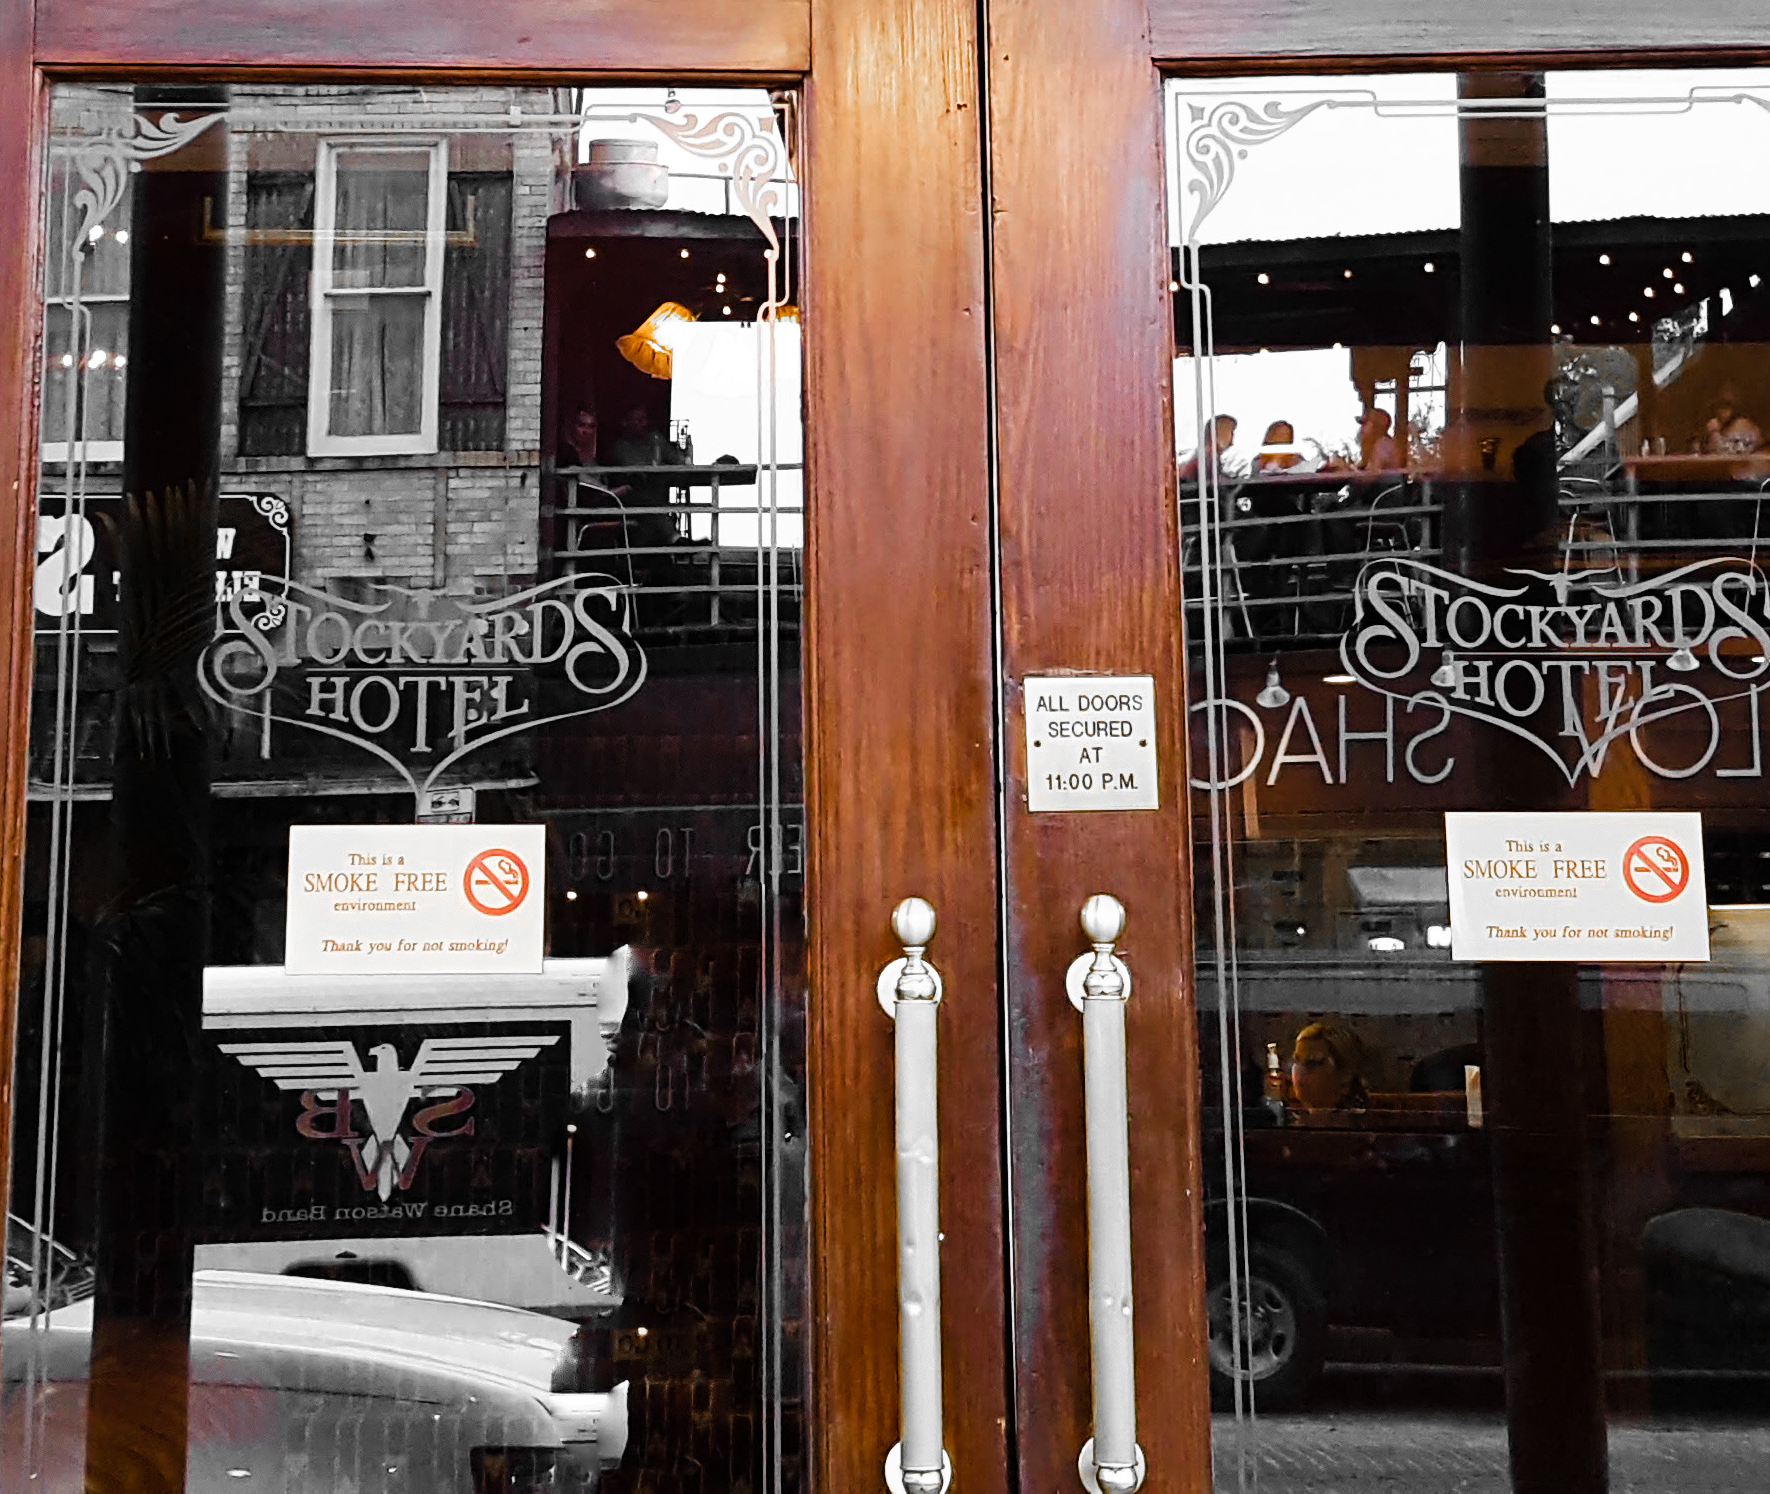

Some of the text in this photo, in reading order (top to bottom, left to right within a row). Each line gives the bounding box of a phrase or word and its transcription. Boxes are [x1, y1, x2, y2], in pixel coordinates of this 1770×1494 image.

[213, 586, 629, 696] STOCKYARDS
[1036, 694, 1143, 712] ALL DOORS
[1450, 659, 1677, 737] HOTEL
[305, 674, 529, 752] HOTEL
[1048, 720, 1133, 738] SECURED
[1078, 747, 1103, 764] AT
[1045, 772, 1139, 791] 11:00 P.M.
[1505, 839, 1562, 853] This is a
[348, 852, 405, 866] This is a
[1463, 859, 1607, 879] SMOKE FREE
[303, 872, 448, 893] SMOKE FREE
[1495, 886, 1577, 899] environment
[334, 899, 417, 912] environment
[1486, 925, 1674, 942] Thank you for not smoking!
[322, 937, 509, 955] Thank you for not smoking!
